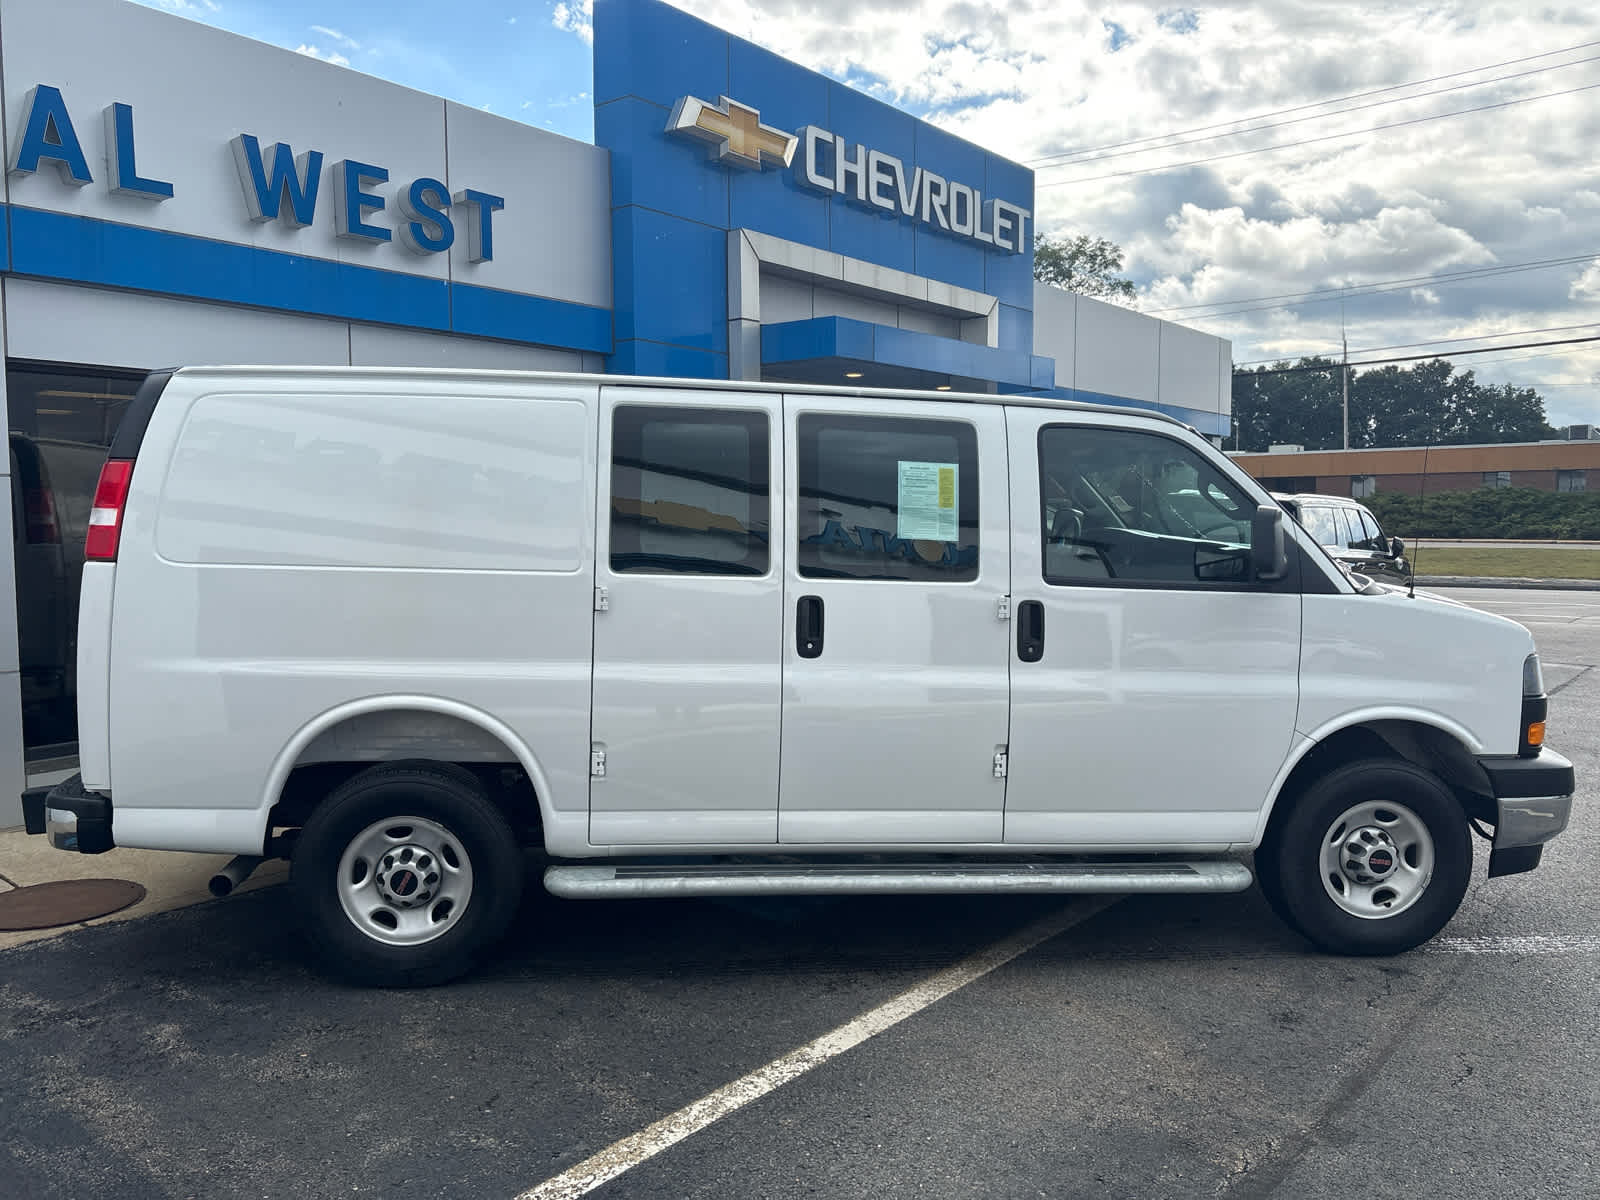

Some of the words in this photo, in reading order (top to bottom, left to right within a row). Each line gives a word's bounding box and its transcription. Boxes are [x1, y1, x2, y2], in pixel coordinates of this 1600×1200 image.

[12, 83, 175, 201] AL
[235, 132, 505, 264] WEST
[804, 124, 1032, 255] CHEVROLET
